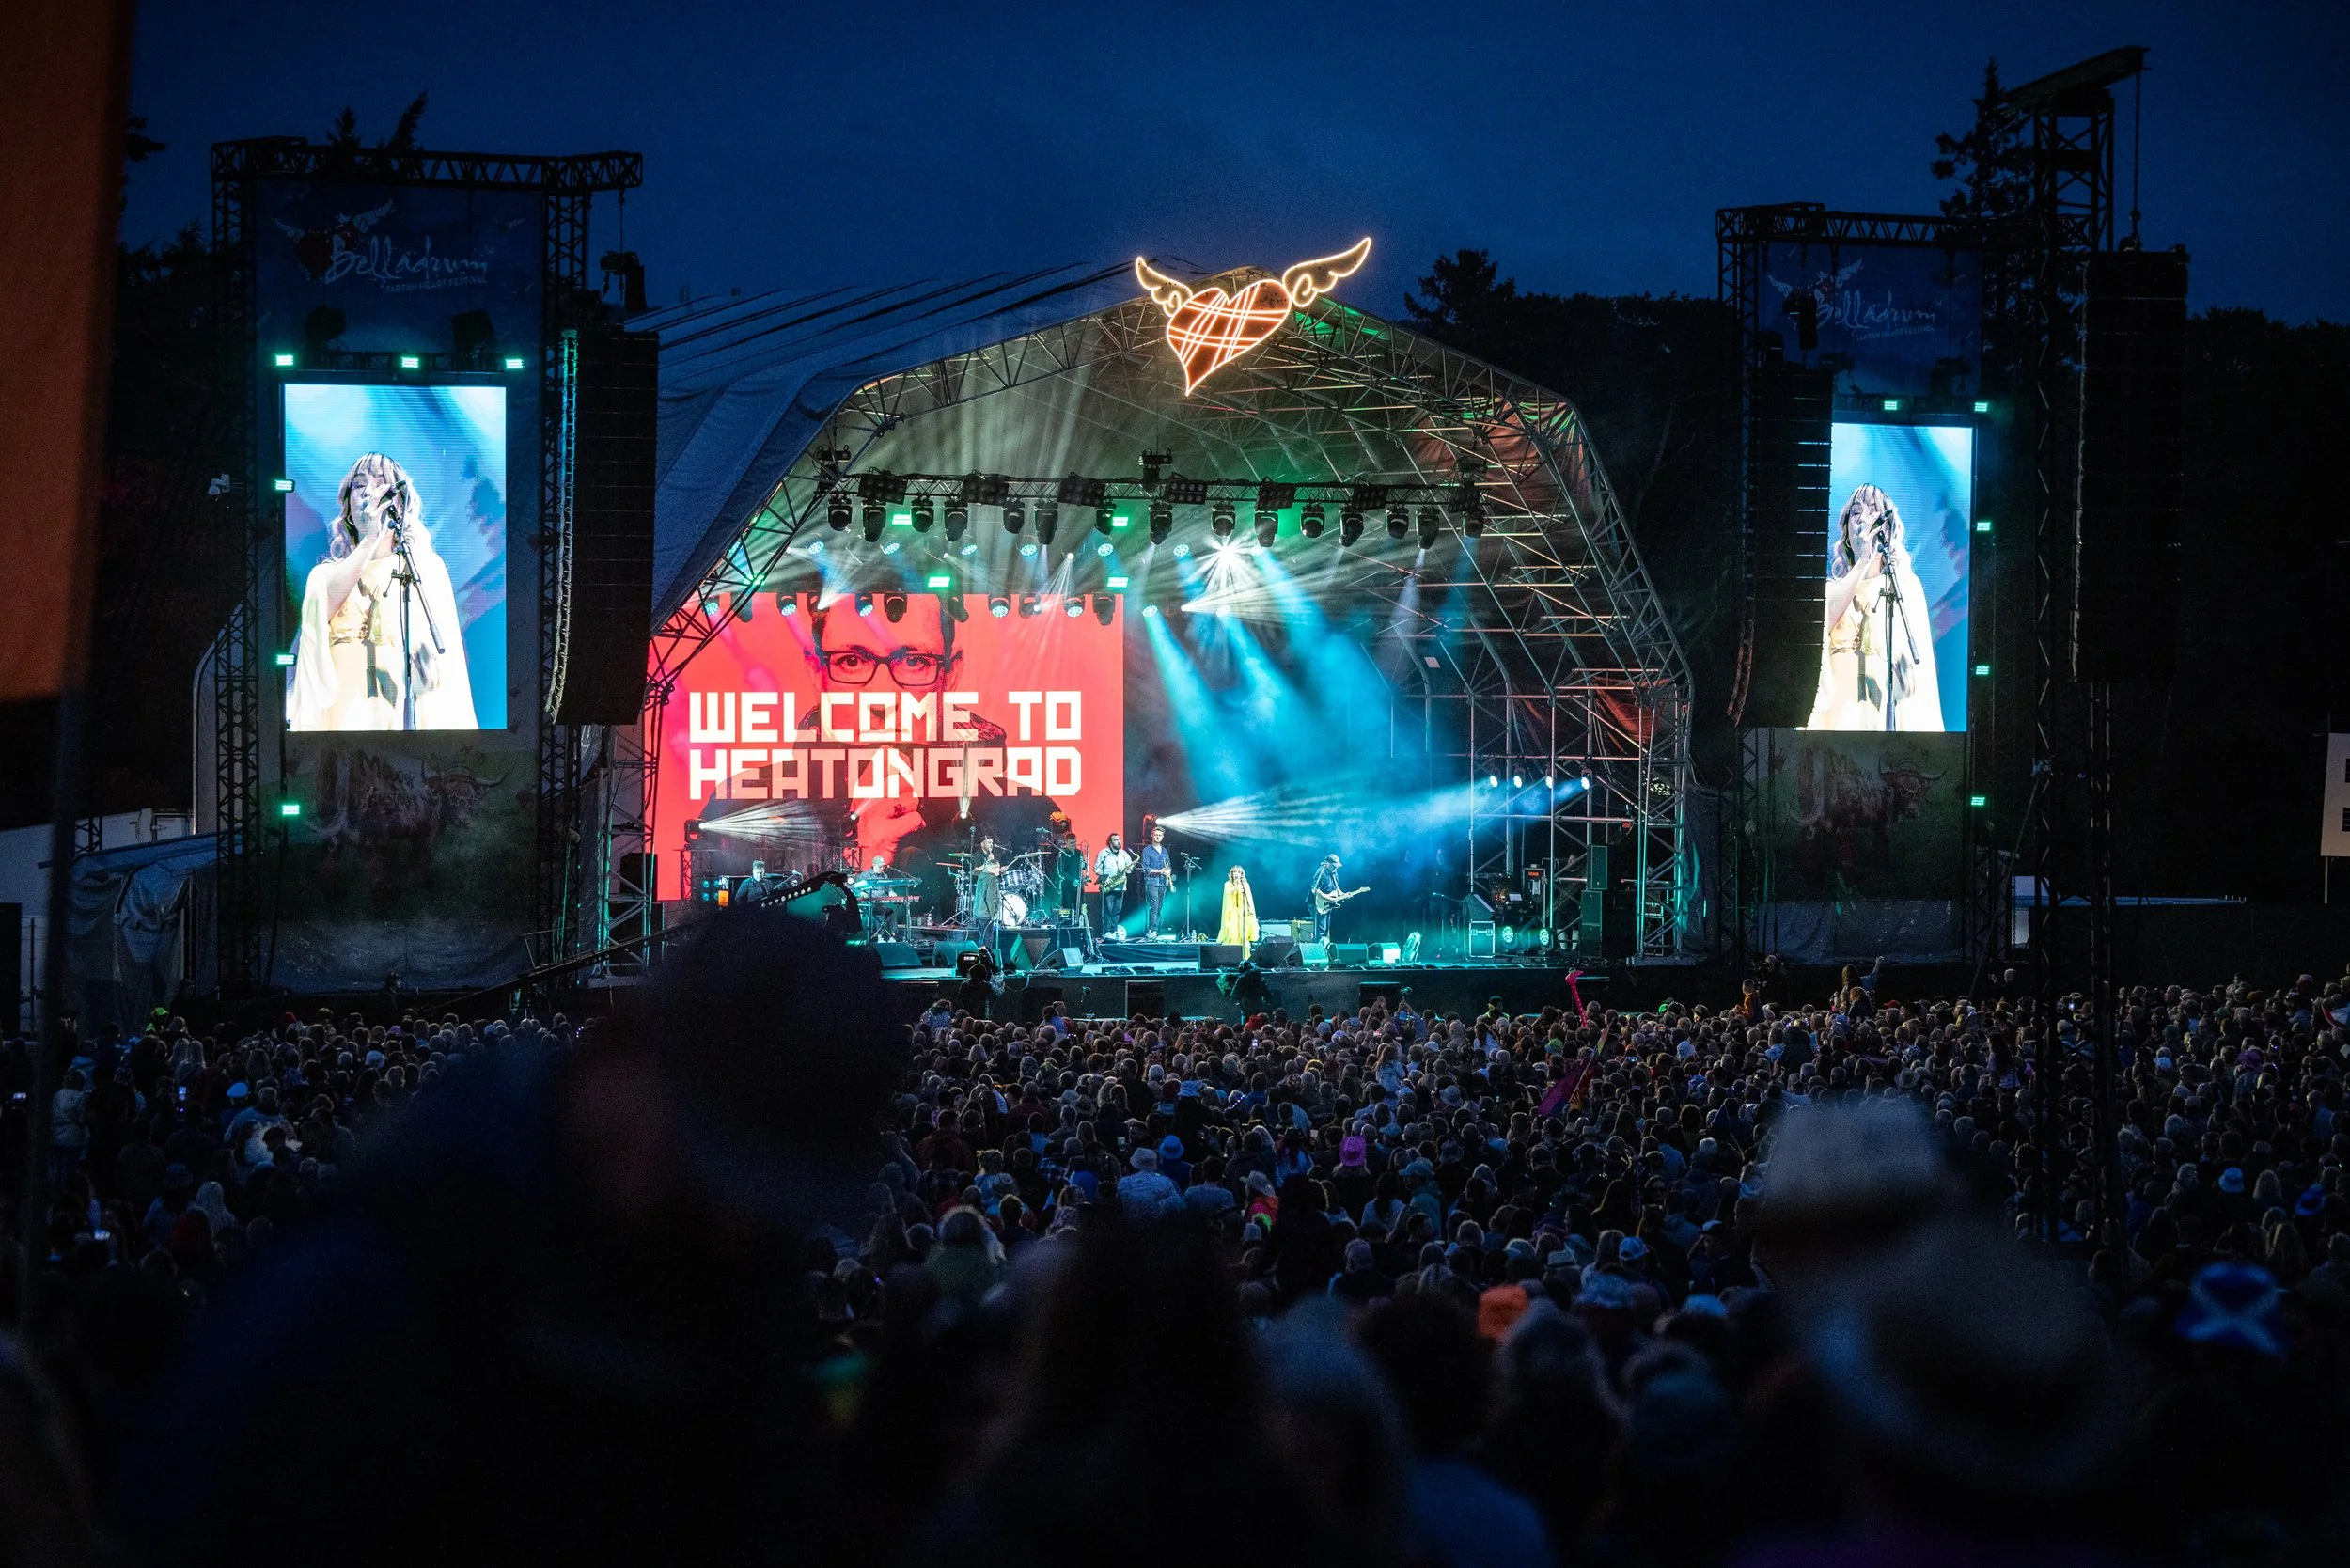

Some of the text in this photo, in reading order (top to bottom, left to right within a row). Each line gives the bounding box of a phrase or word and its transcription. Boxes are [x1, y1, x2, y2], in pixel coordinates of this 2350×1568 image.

[324, 234, 488, 285] Belladrum
[689, 691, 1082, 744] WELCOME TO
[689, 747, 1082, 800] HEATONGRAD
